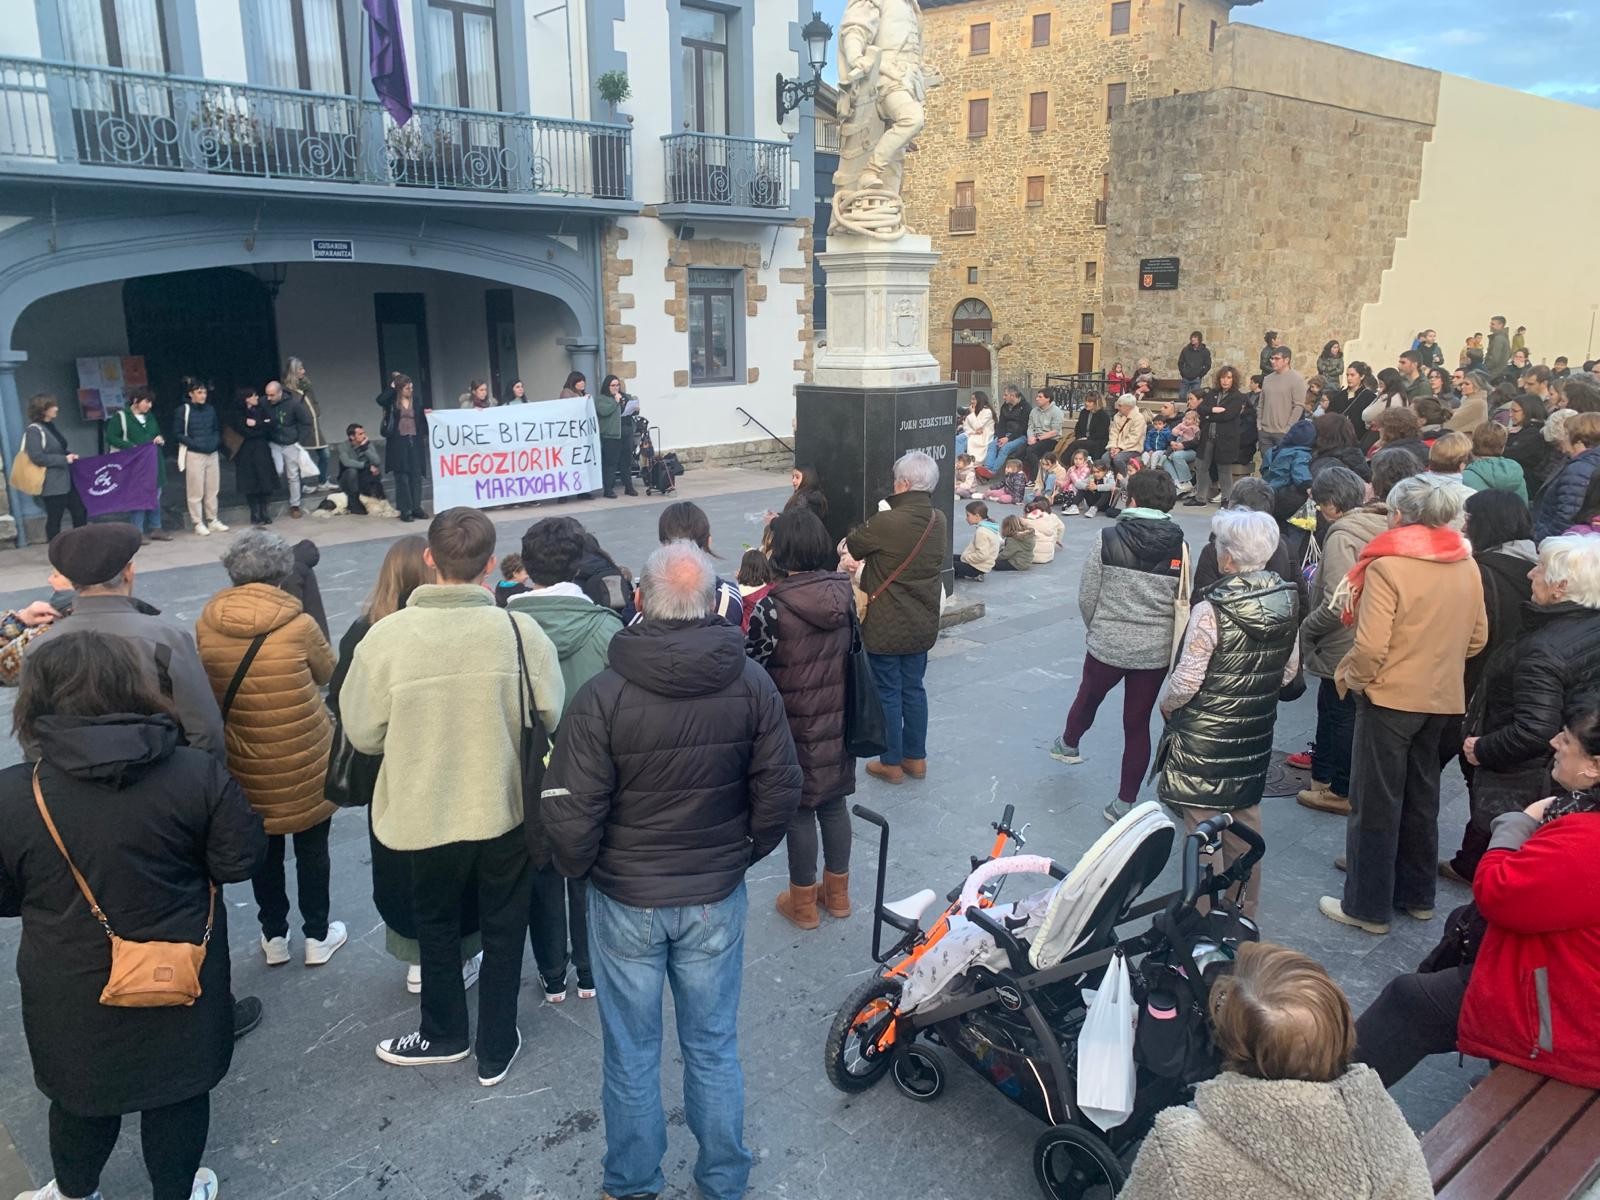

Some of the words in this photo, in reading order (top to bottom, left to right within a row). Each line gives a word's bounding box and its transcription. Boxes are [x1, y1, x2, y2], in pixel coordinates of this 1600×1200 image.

[432, 424, 491, 449] GURE
[499, 416, 597, 443] BIZITZEKIN
[899, 420, 917, 430] JUAN
[918, 416, 953, 428] SEBASTIAN
[440, 447, 564, 477] NEGOZIORIK
[571, 445, 597, 466] EZ!
[475, 472, 569, 500] MARTXOAK
[573, 471, 582, 490] 8
